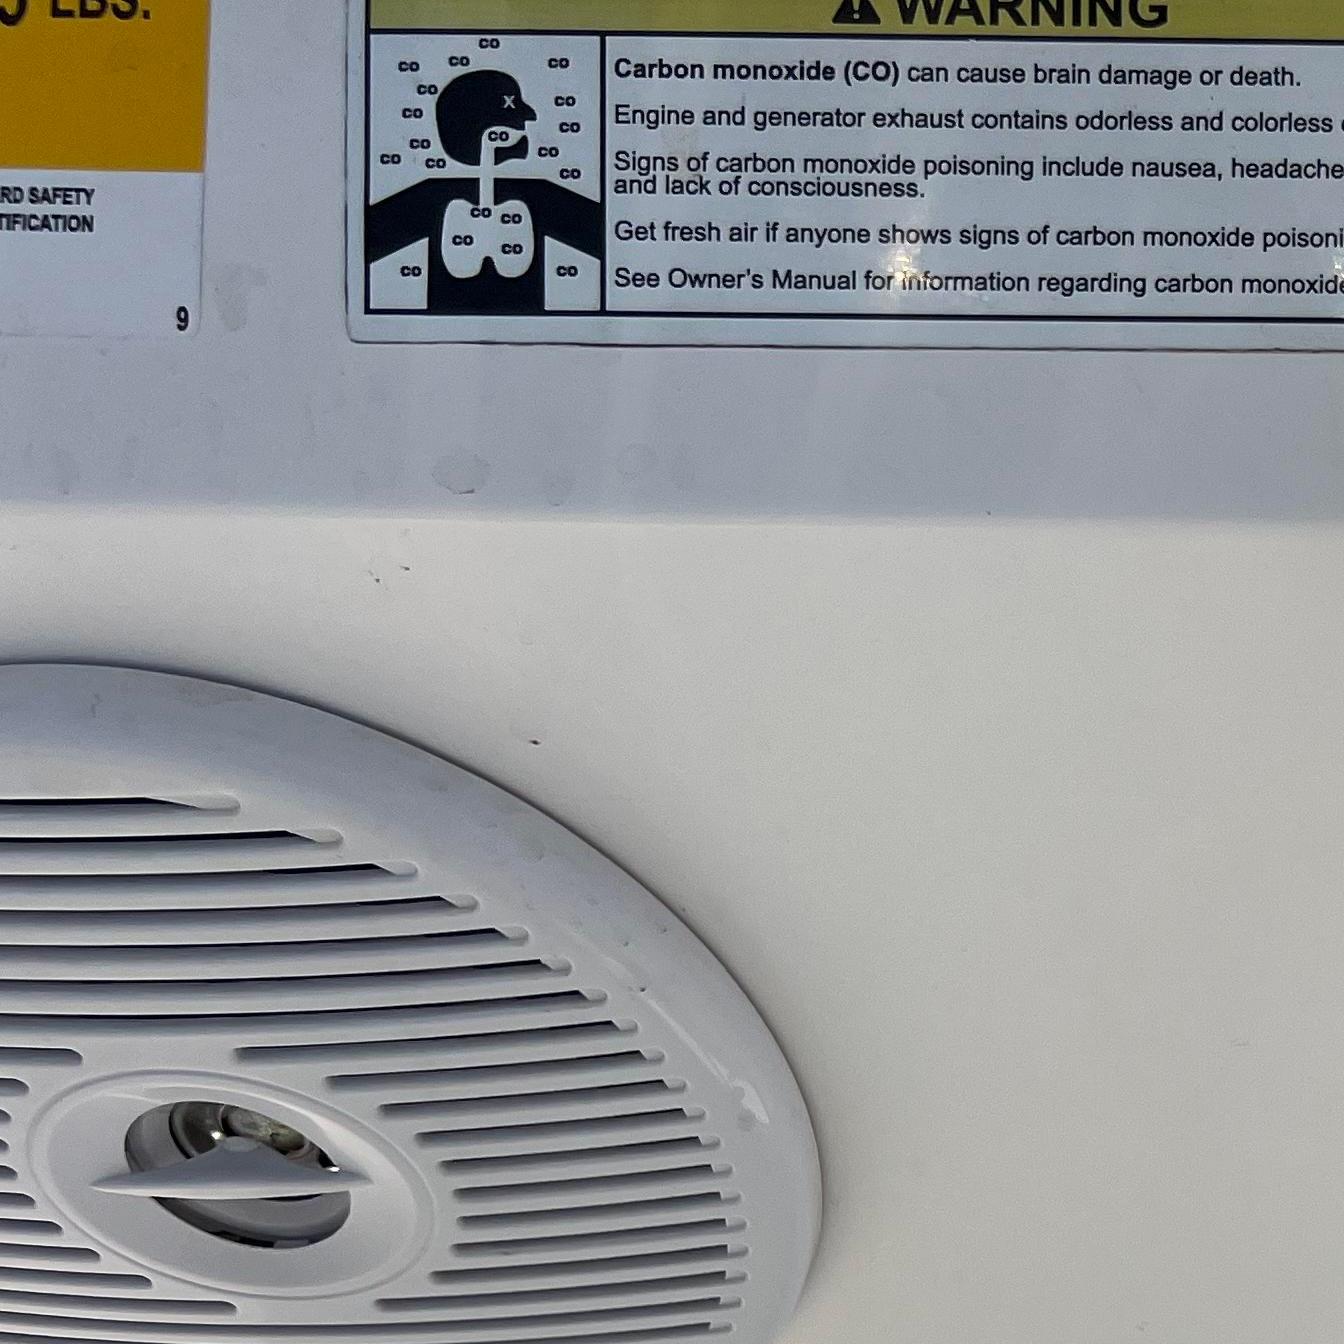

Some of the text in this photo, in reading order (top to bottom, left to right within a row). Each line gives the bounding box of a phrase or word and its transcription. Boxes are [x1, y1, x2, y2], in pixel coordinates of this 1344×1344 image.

[896, 0, 1168, 28] WARNING
[479, 38, 500, 49] CO
[398, 61, 419, 72] CO
[448, 56, 470, 67] CO
[548, 58, 569, 68] CO
[614, 58, 1300, 90] Carbon monoxide (CO) can cause brain damage or death.
[417, 84, 438, 95] CO
[554, 96, 576, 106] CO
[402, 108, 423, 119] CO
[615, 104, 694, 130] Engine
[702, 106, 745, 126] and
[753, 108, 866, 131] generator
[872, 108, 964, 129] exhaust
[971, 109, 1068, 130] contains
[1075, 111, 1173, 131] odorless
[1181, 111, 1223, 131] and
[1231, 112, 1333, 133] colorless
[559, 122, 580, 133] CO
[488, 131, 509, 142] CO
[409, 139, 430, 149] CO
[538, 147, 559, 157] CO
[380, 154, 401, 164] CO
[425, 158, 446, 169] CO
[614, 151, 679, 177] Signs
[686, 152, 710, 173] of
[716, 153, 794, 173] carbon
[803, 154, 915, 175] monoxide
[924, 155, 1034, 181] poisoning
[1042, 156, 1123, 177] include
[1132, 161, 1222, 181] nausea,
[560, 168, 581, 179] CO
[614, 175, 924, 198] and lack of consciousness.
[0, 186, 95, 206] RD SAFETY
[470, 207, 492, 218] CO
[501, 213, 522, 224] CO
[452, 235, 474, 246] CO
[615, 220, 657, 241] Get
[662, 221, 720, 242] fresh
[729, 222, 758, 242] air
[766, 222, 779, 242] if
[785, 227, 870, 248] anyone
[878, 224, 952, 244] shows
[959, 225, 1019, 250] signs
[1027, 224, 1050, 245] of
[1056, 226, 1134, 246] carbon
[1142, 227, 1255, 248] monoxide
[501, 243, 523, 254] CO
[400, 266, 422, 277] CO
[556, 266, 578, 277] CO
[614, 267, 660, 288] See
[668, 268, 764, 289] Owner's
[772, 269, 856, 290] Manual
[863, 269, 895, 291] for
[902, 271, 1029, 292] information
[1038, 272, 1146, 297] regarding
[1154, 272, 1233, 293] carbon
[175, 305, 190, 331] 9
